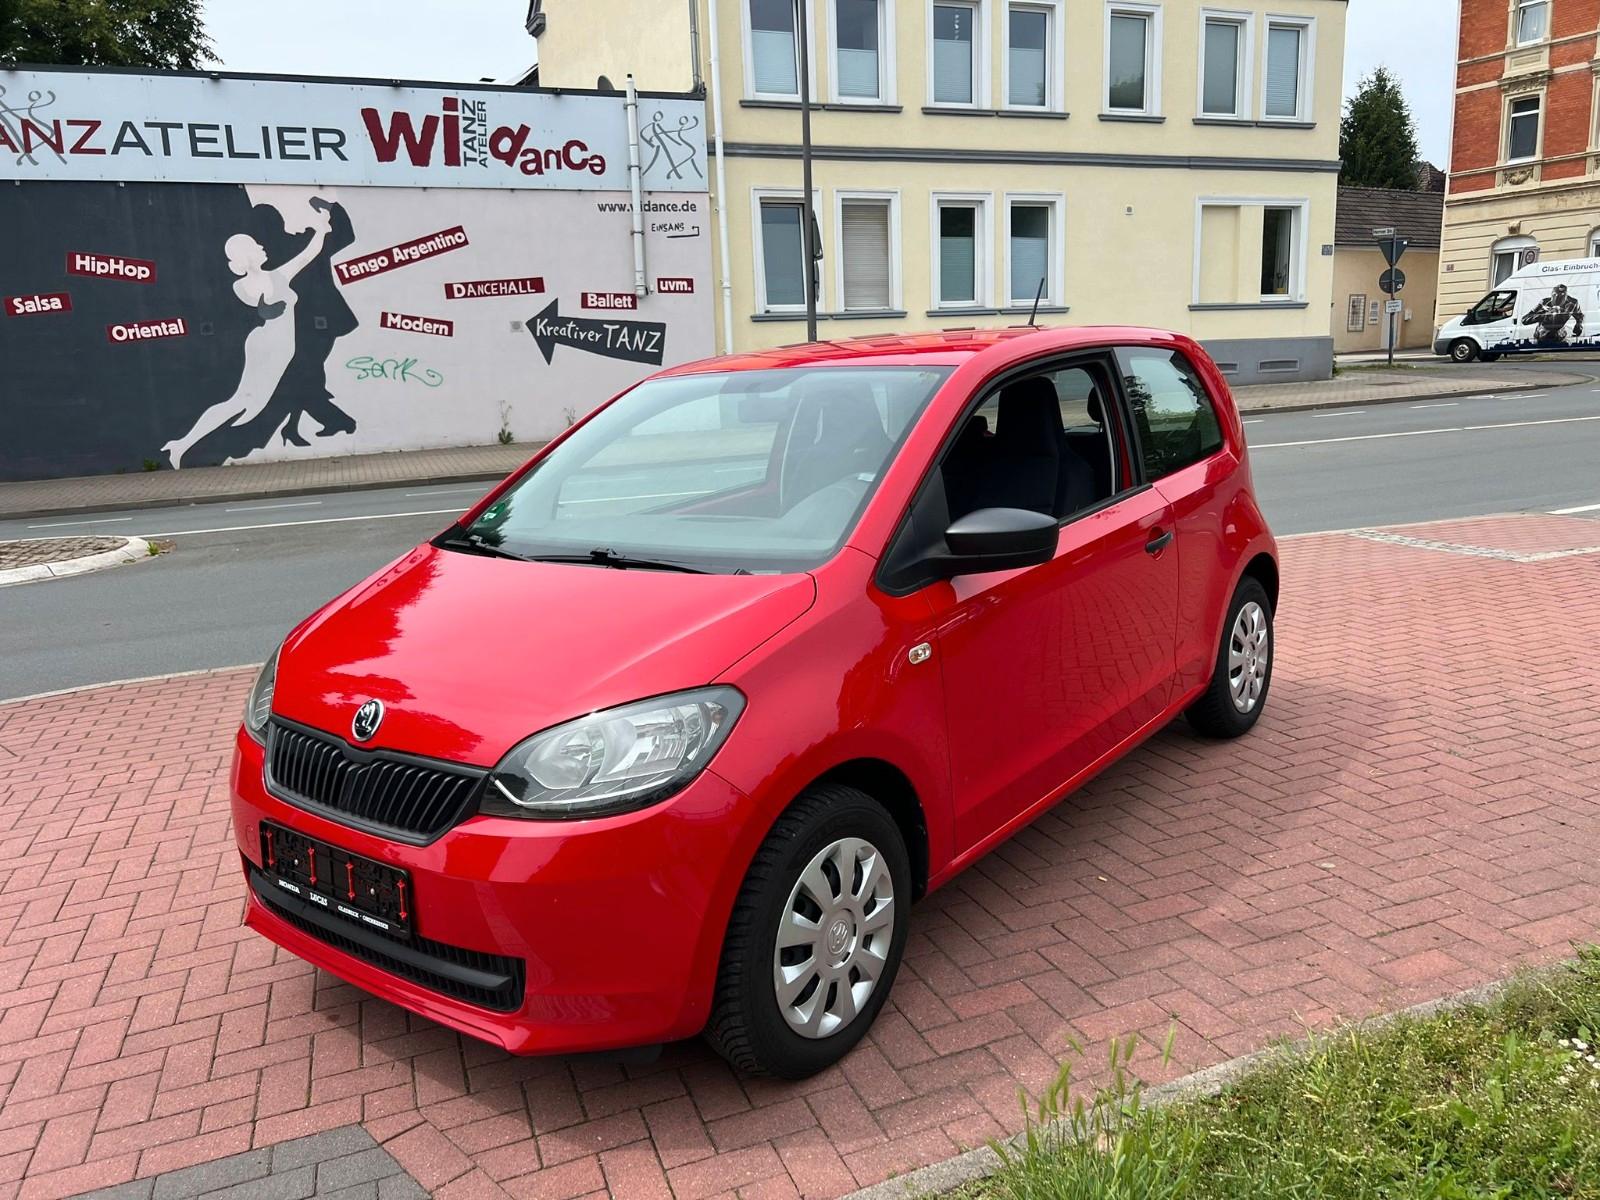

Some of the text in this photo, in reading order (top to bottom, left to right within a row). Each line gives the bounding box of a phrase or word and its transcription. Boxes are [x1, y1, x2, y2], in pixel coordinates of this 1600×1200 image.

[461, 99, 478, 167] TANZ
[477, 100, 488, 169] ATELIER
[338, 231, 466, 279] Tango Argentino
[75, 254, 151, 281] HipHop
[452, 280, 537, 298] DANCEHALL
[659, 281, 692, 291] uvm.
[13, 296, 63, 314] Salsa
[587, 293, 633, 308] Ballett
[111, 318, 185, 341] Oriental
[386, 312, 449, 335] Modern
[536, 318, 662, 353] Kreativer TANZ
